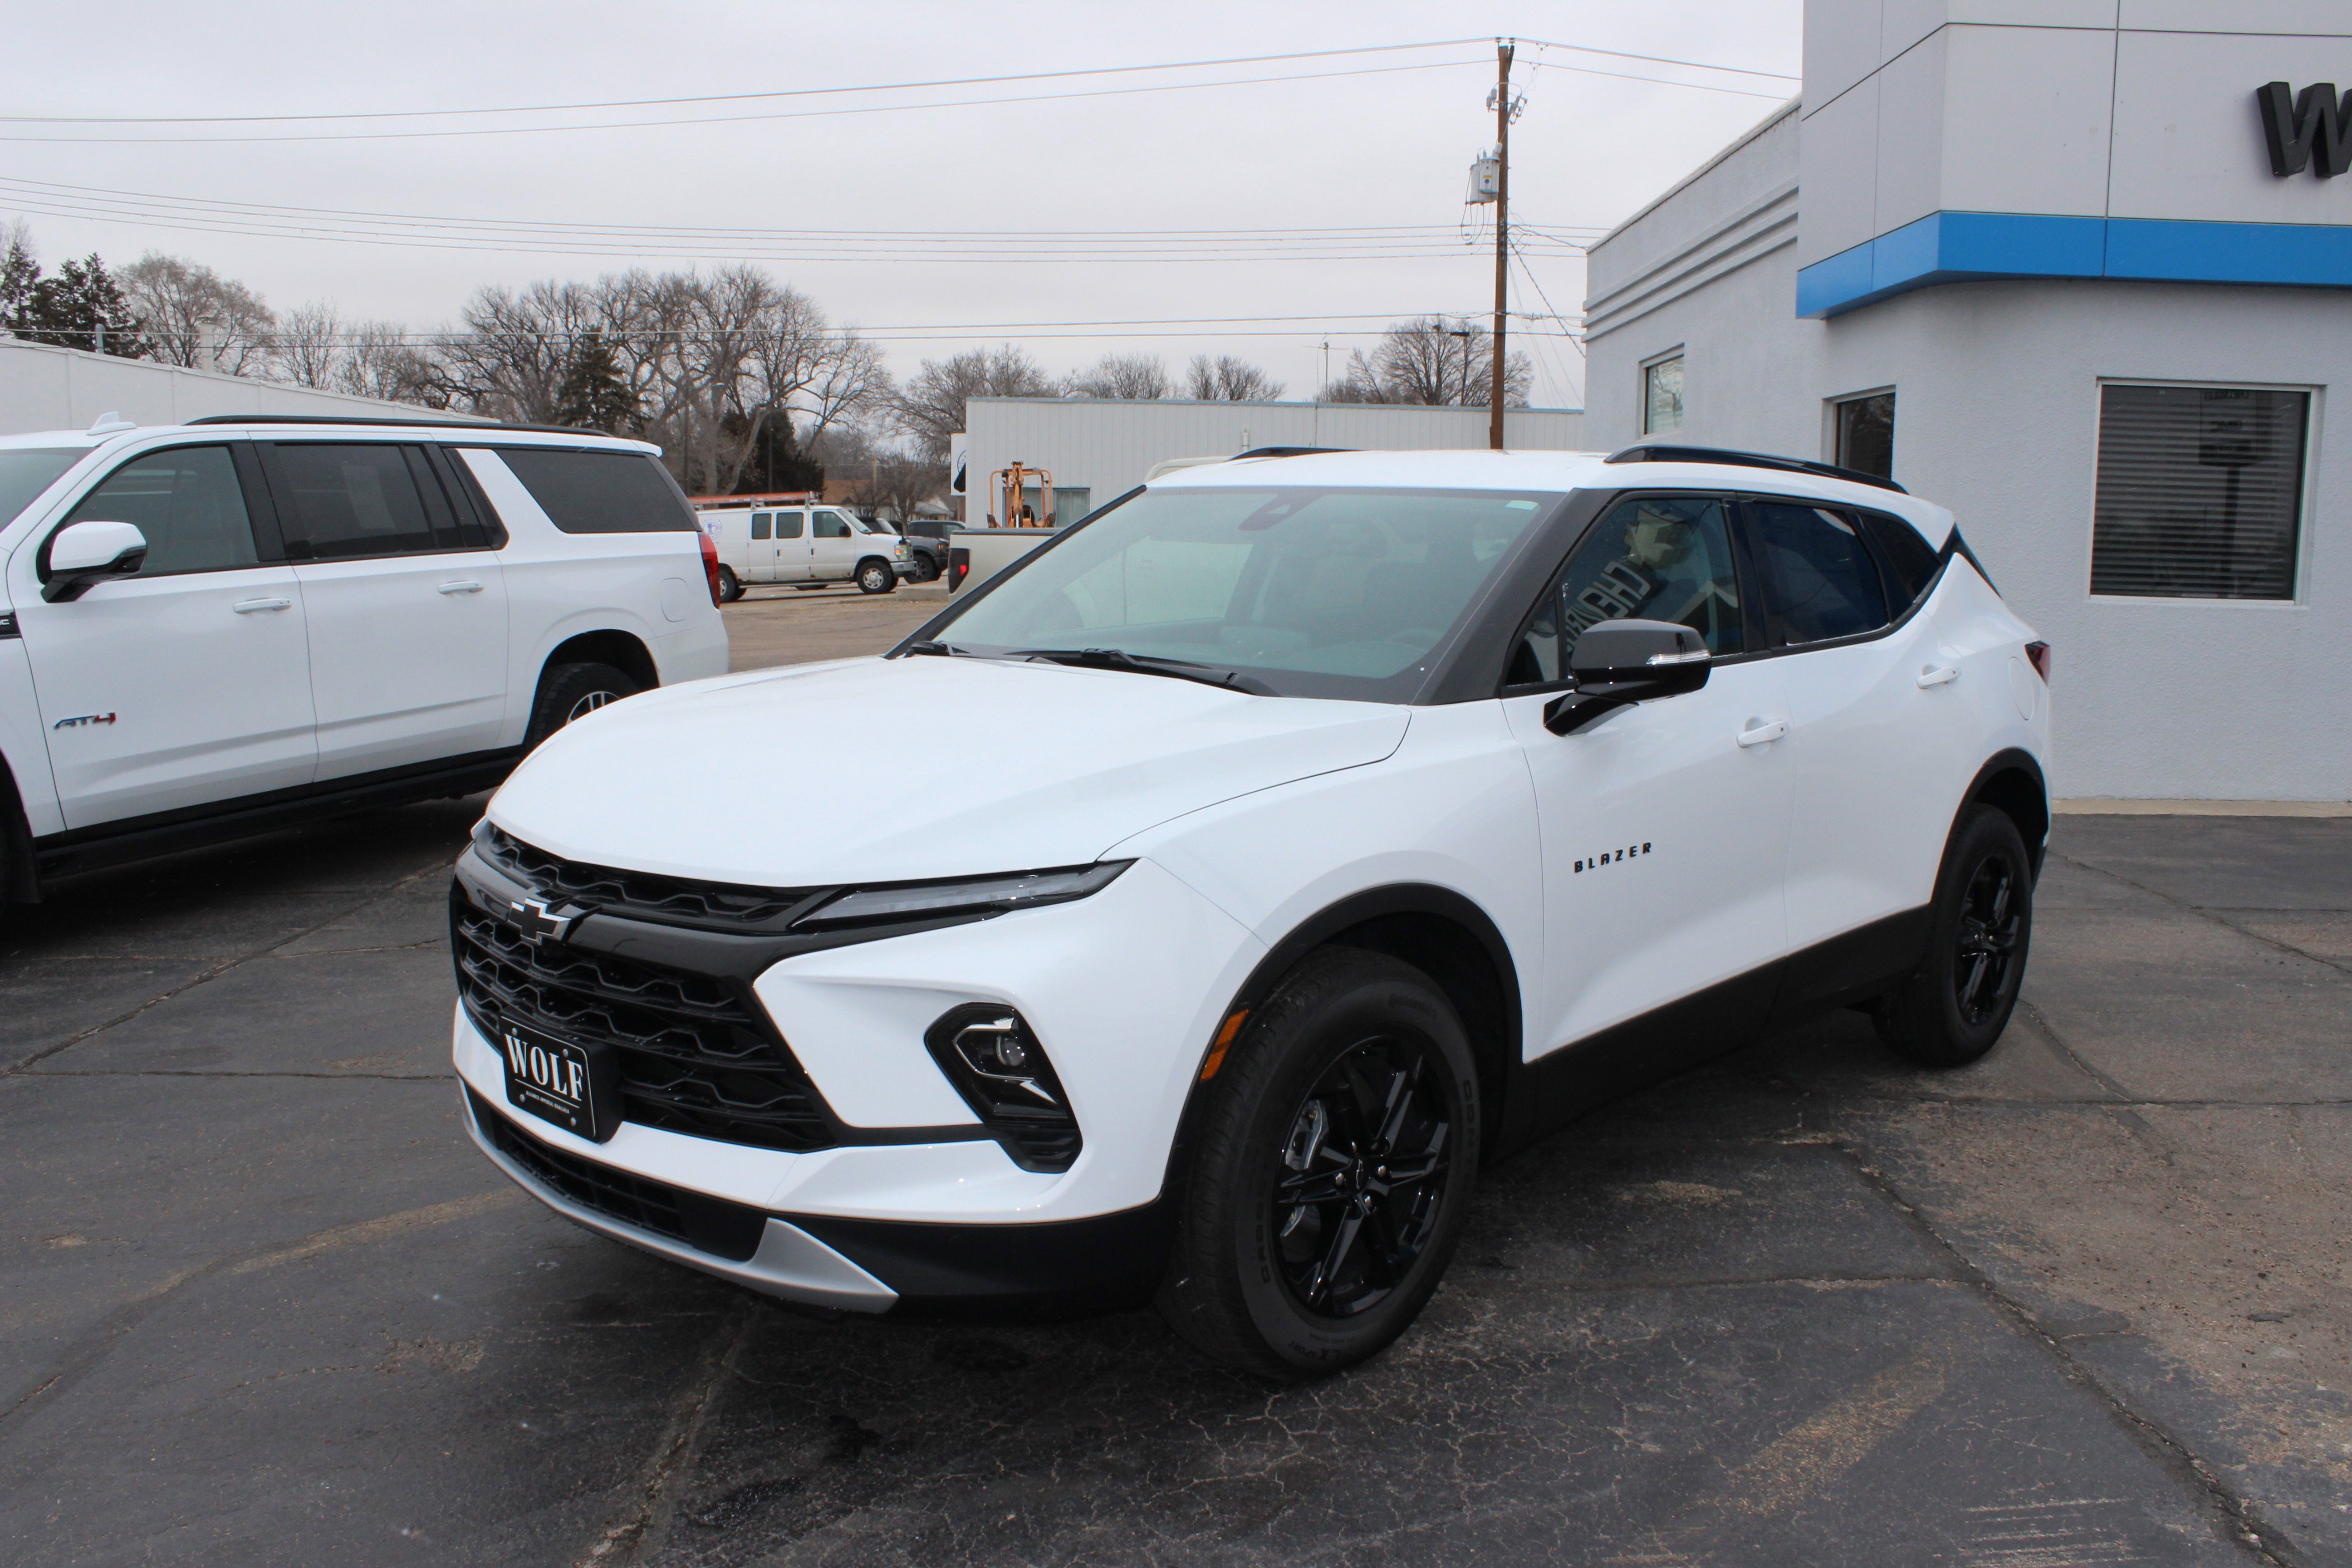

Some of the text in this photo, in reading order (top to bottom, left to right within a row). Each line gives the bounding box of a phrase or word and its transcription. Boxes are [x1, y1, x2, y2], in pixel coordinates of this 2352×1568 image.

[54, 712, 116, 730] AT4
[1574, 843, 1651, 873] BLAZER
[504, 1033, 583, 1102] WOLF
